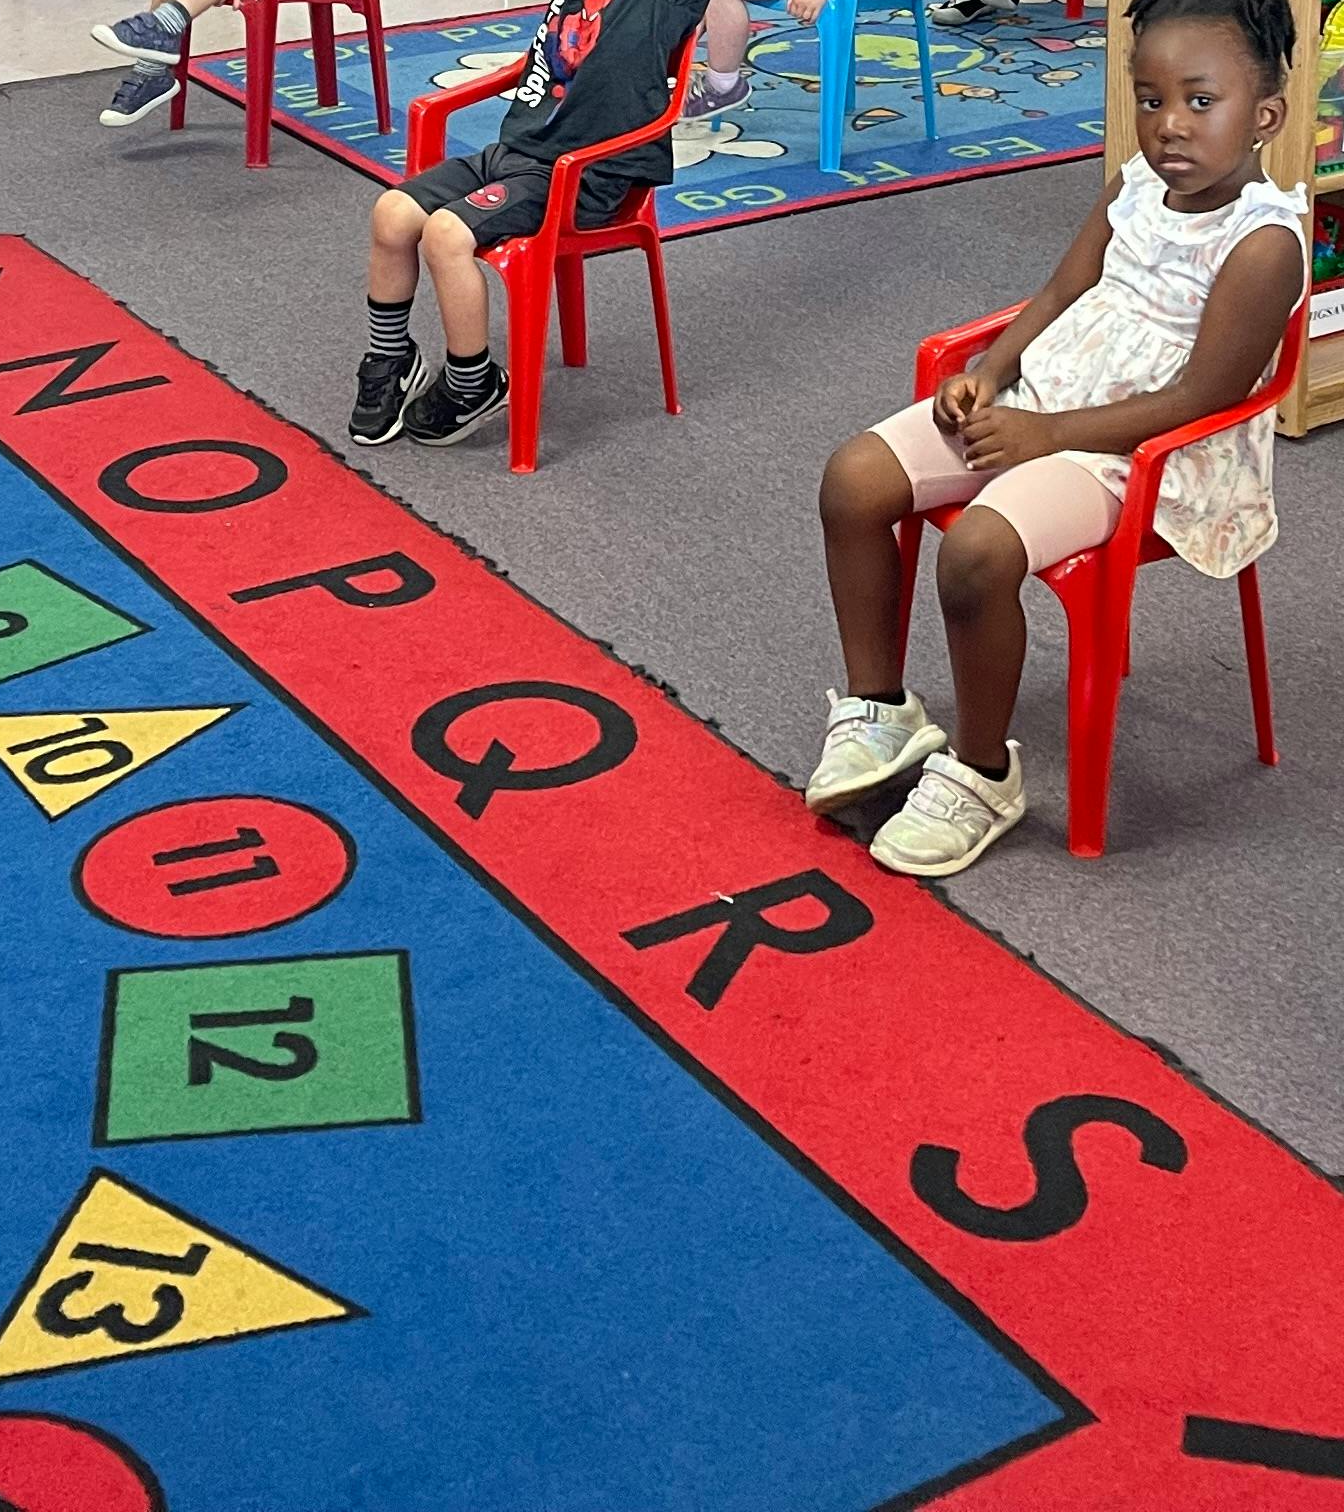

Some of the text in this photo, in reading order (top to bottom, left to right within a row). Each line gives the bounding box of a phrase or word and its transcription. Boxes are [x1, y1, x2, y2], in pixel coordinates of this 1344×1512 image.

[6, 716, 135, 785] 10
[99, 439, 288, 513] O
[231, 551, 435, 608] P
[411, 680, 638, 819] Q
[621, 867, 875, 1010] R
[909, 1092, 1188, 1242] S
[152, 827, 280, 896] 11
[187, 995, 319, 1088] 12
[35, 1242, 211, 1345] 13
